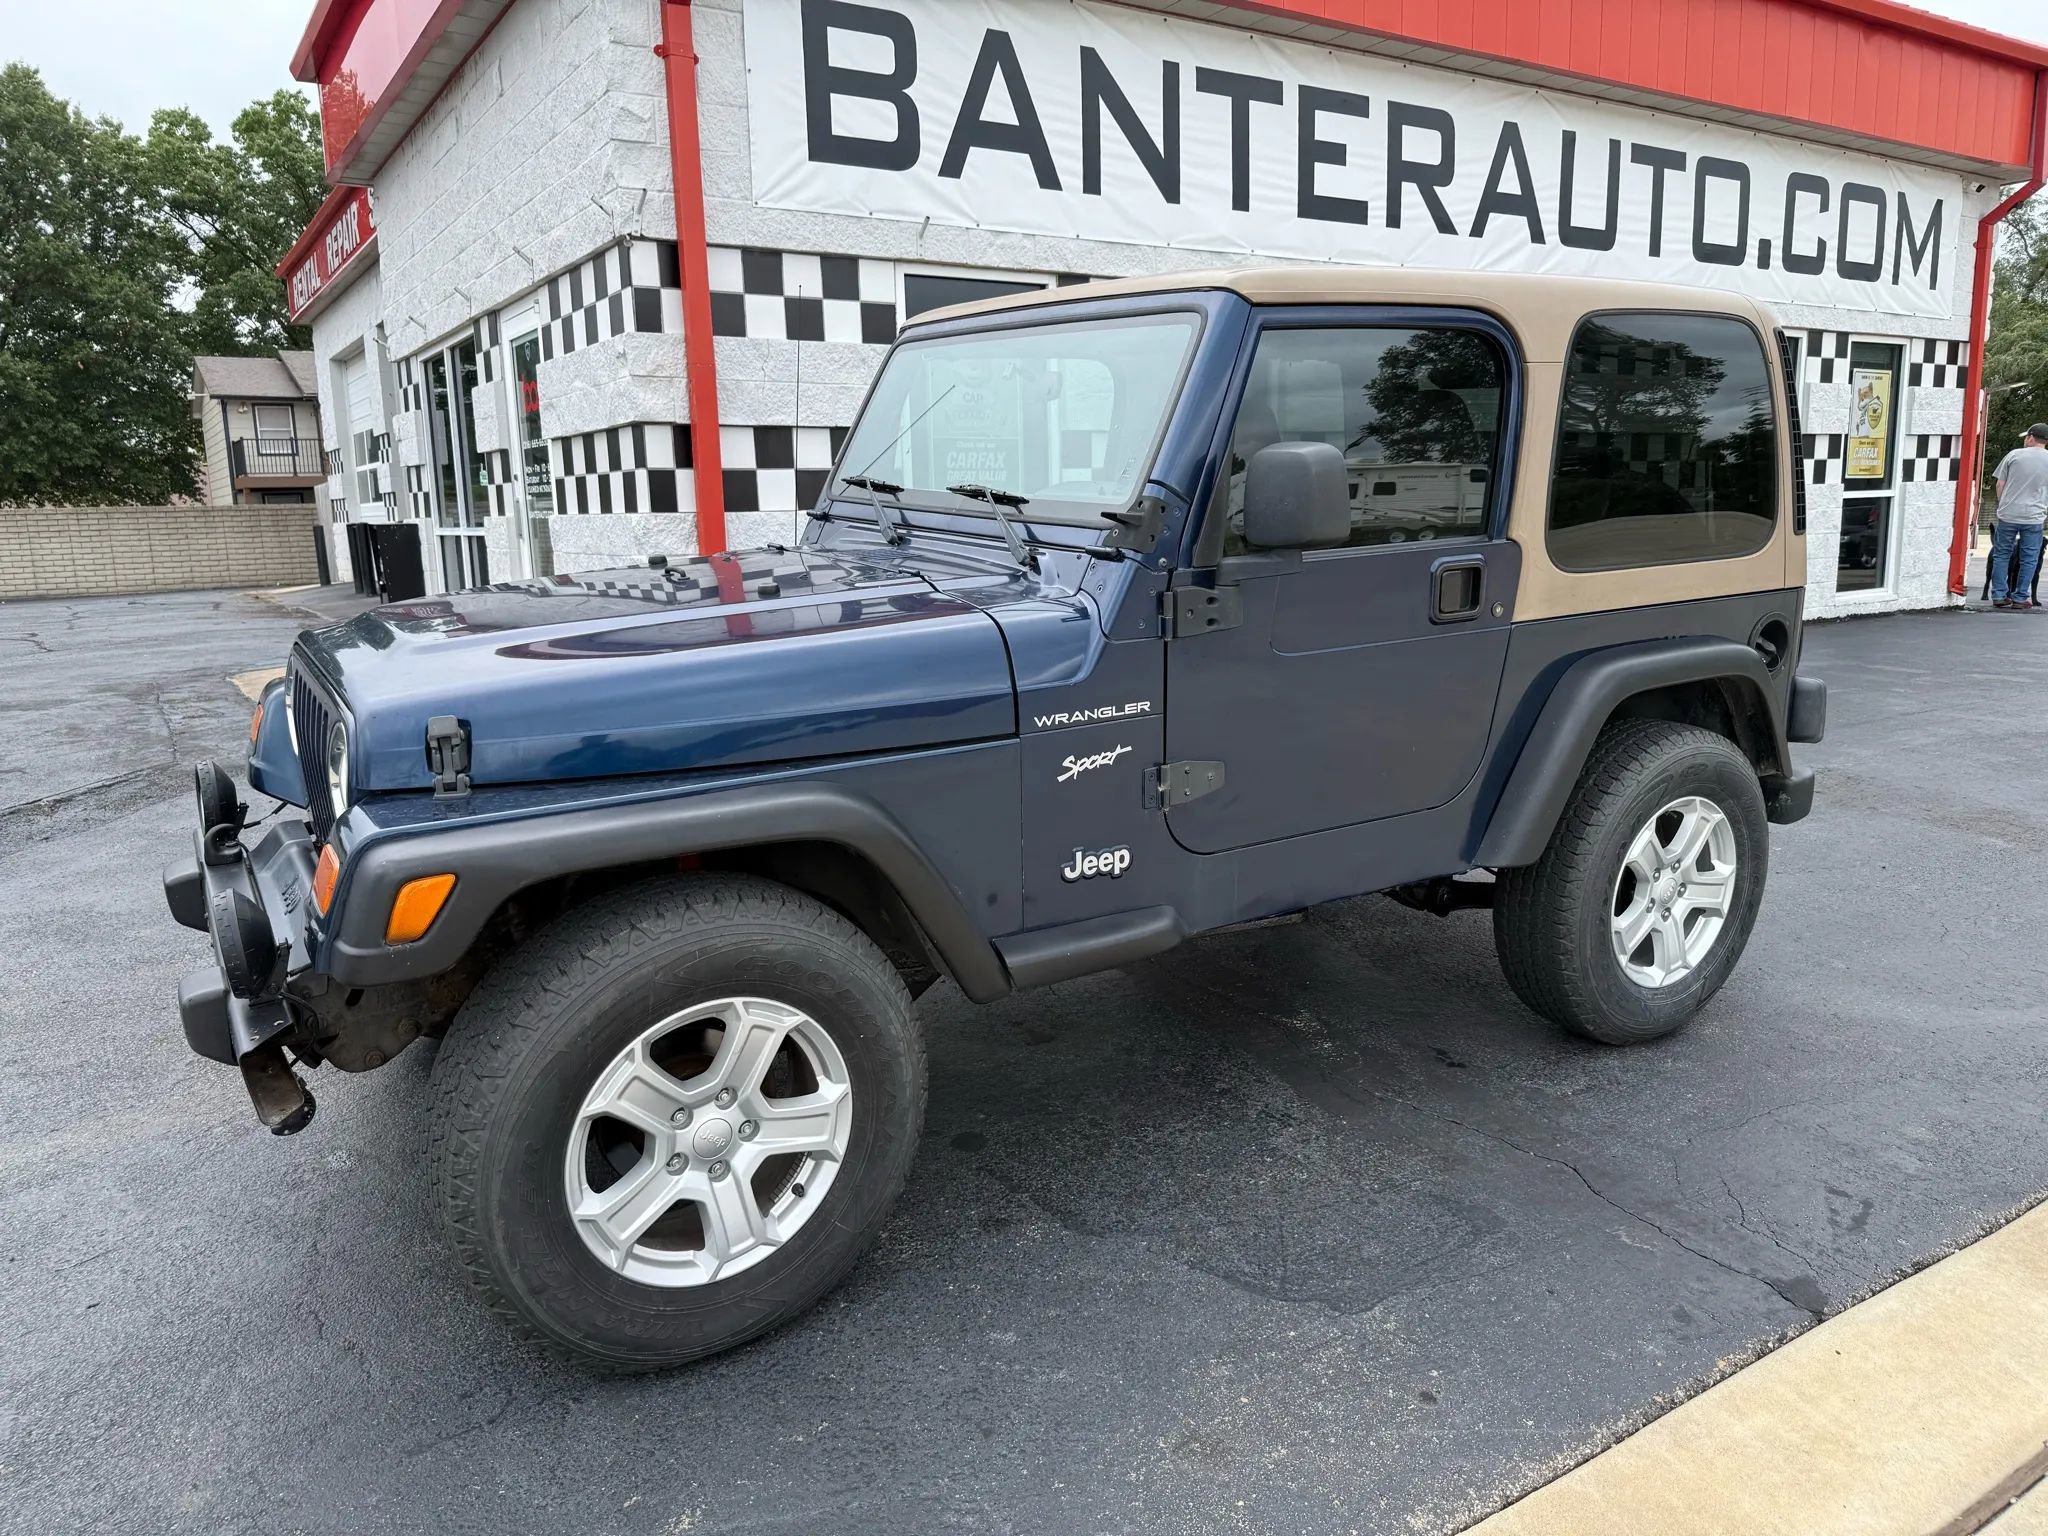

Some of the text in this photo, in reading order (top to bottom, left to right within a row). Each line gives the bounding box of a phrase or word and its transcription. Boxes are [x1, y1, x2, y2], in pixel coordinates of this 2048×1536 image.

[801, 0, 1944, 291] BANTERAUTO.COM
[292, 202, 361, 311] RENTAL REPAIR
[946, 450, 1007, 469] CARFAX
[946, 470, 1008, 481] GREAT VALUE
[1033, 700, 1151, 728] WRANGLER
[1056, 743, 1133, 783] Sport
[1064, 847, 1131, 880] Jeep
[700, 1129, 726, 1148] Jeep
